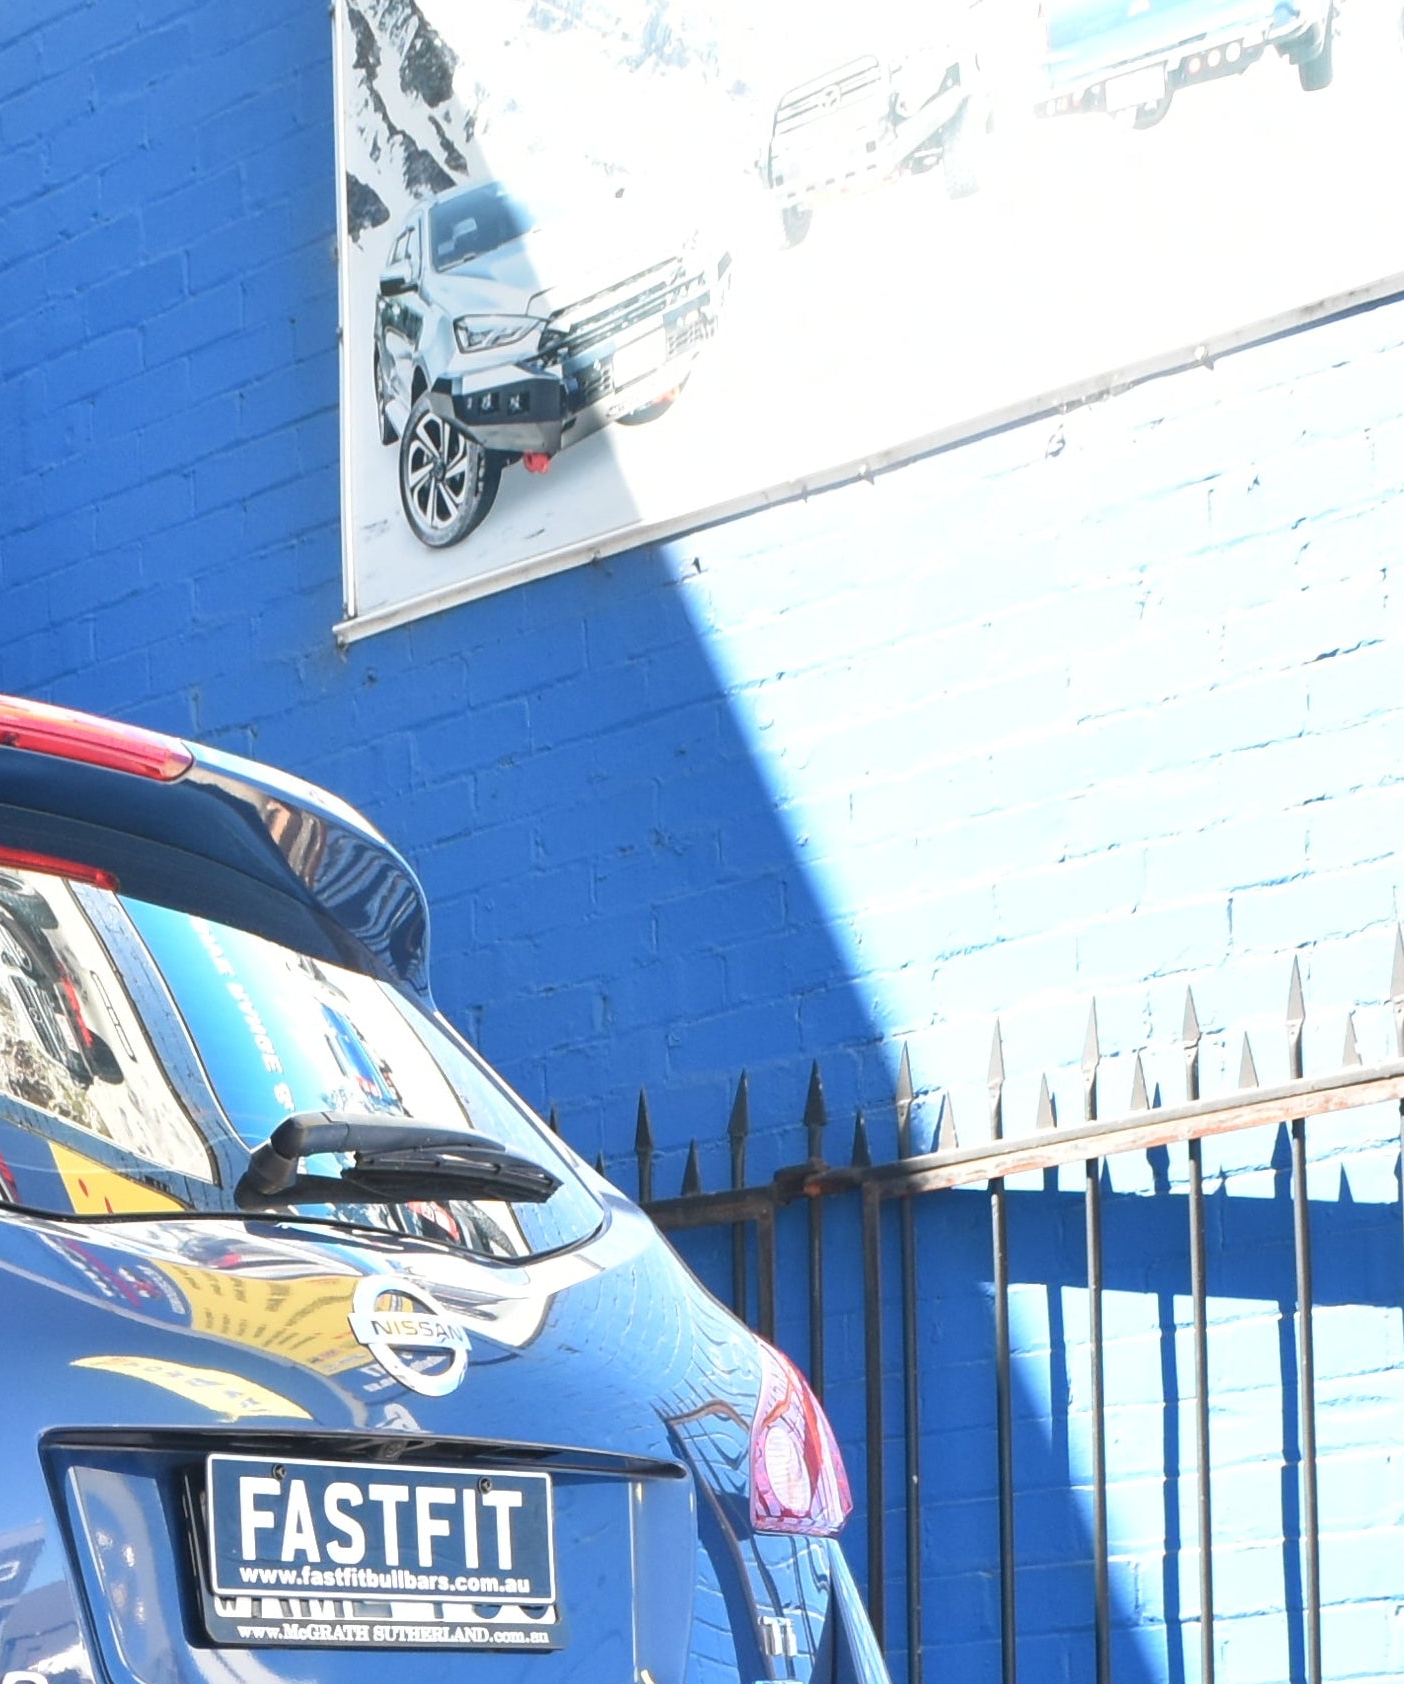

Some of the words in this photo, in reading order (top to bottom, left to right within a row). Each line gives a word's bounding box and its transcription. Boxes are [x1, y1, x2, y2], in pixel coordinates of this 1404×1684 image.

[370, 1319, 464, 1350] NISSAN
[239, 1476, 523, 1571] FASTFIT
[239, 1566, 531, 1594] www.fastfitbullbars.com.au
